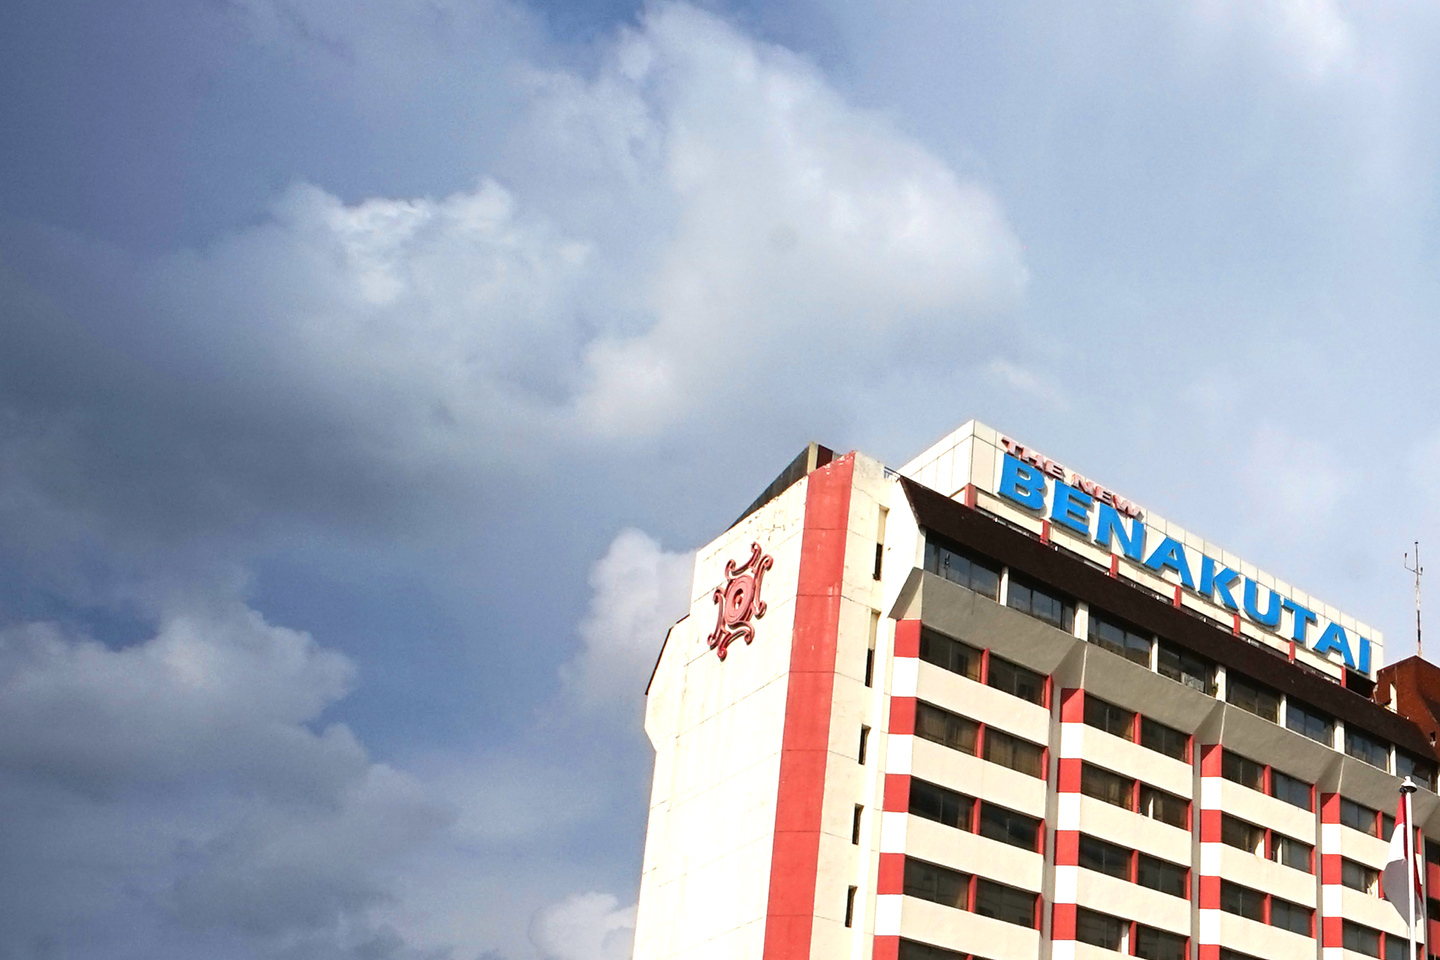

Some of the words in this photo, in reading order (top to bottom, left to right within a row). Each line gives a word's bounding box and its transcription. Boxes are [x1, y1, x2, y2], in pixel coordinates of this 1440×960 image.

[1001, 437, 1066, 483] THE
[1071, 473, 1145, 523] NEW
[997, 451, 1373, 675] BENAKUTAI
